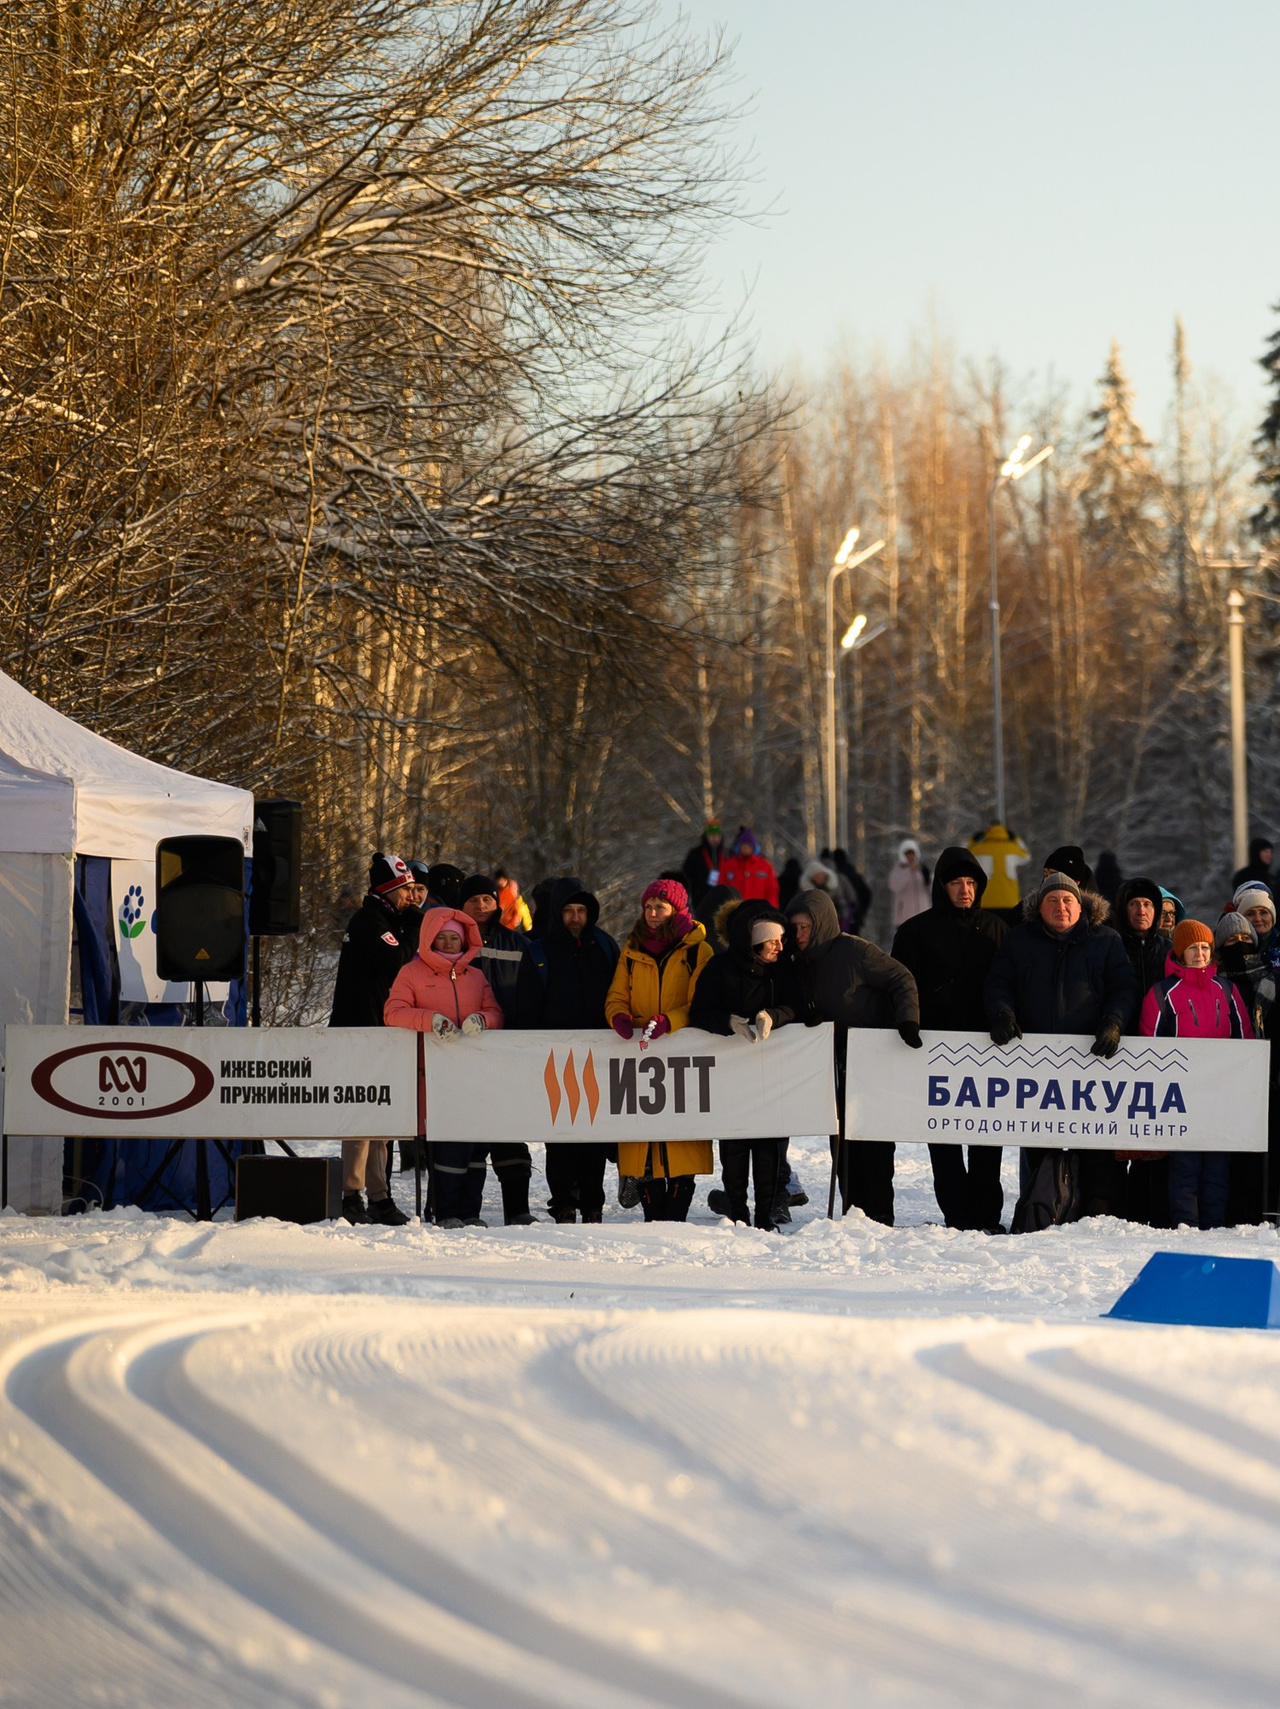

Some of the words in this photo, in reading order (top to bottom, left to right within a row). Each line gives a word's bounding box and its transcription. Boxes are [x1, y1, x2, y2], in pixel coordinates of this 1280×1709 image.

[220, 1057, 312, 1079] ИЖЕВСКИЙ
[333, 1085, 392, 1106] ЗАВОД
[609, 1056, 715, 1115] ИЗТТ
[98, 1097, 145, 1106] 2001
[928, 1075, 1187, 1119] БАРРАКУДА
[927, 1117, 1118, 1136] ОРТОДОНТИЧЕСКИЙ
[1129, 1123, 1188, 1138] ЦЕНТР
